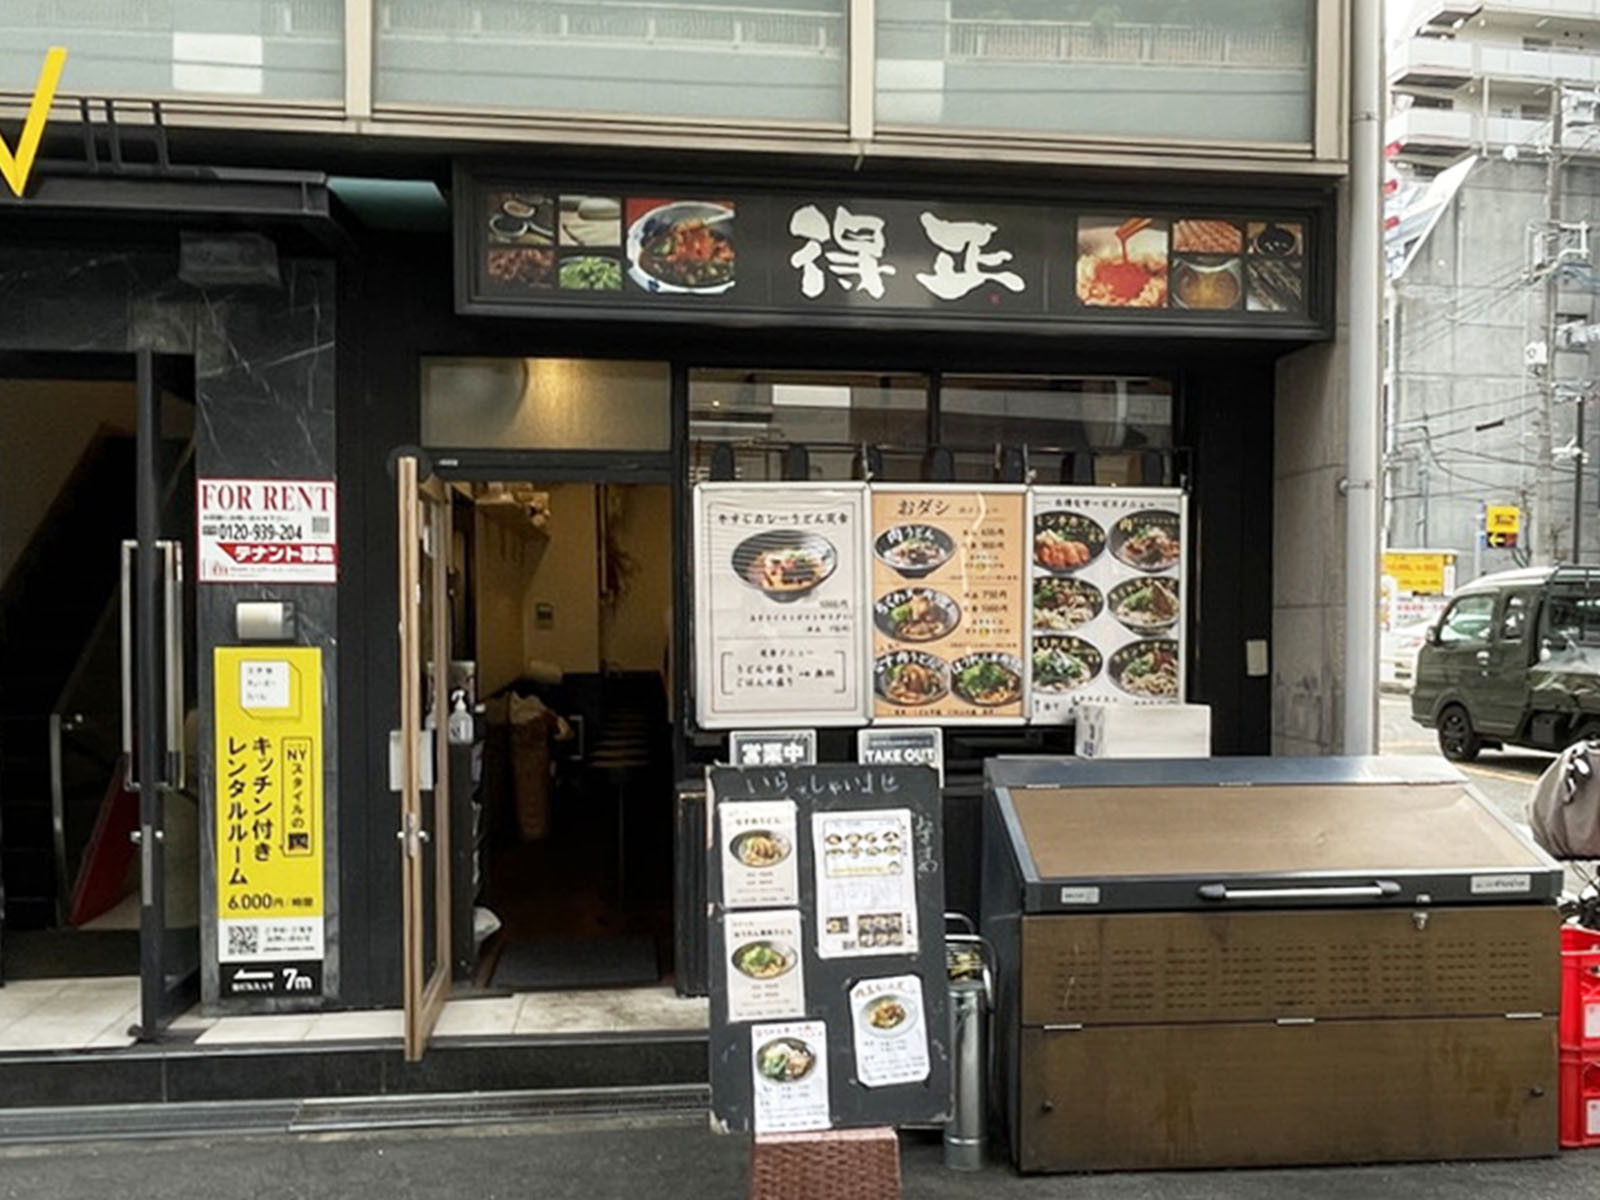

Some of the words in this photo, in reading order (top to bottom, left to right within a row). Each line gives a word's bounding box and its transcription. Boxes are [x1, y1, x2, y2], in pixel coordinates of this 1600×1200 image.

[790, 205, 1025, 300] 得正
[202, 484, 252, 510] FOR
[264, 485, 336, 512] RENT
[219, 523, 302, 541] 0120-939-204
[742, 743, 805, 764] 営業中
[865, 749, 902, 764] TAKE
[228, 736, 248, 885] レンタルルーム
[252, 737, 273, 862] キッチン付き
[282, 967, 313, 990] 7m
